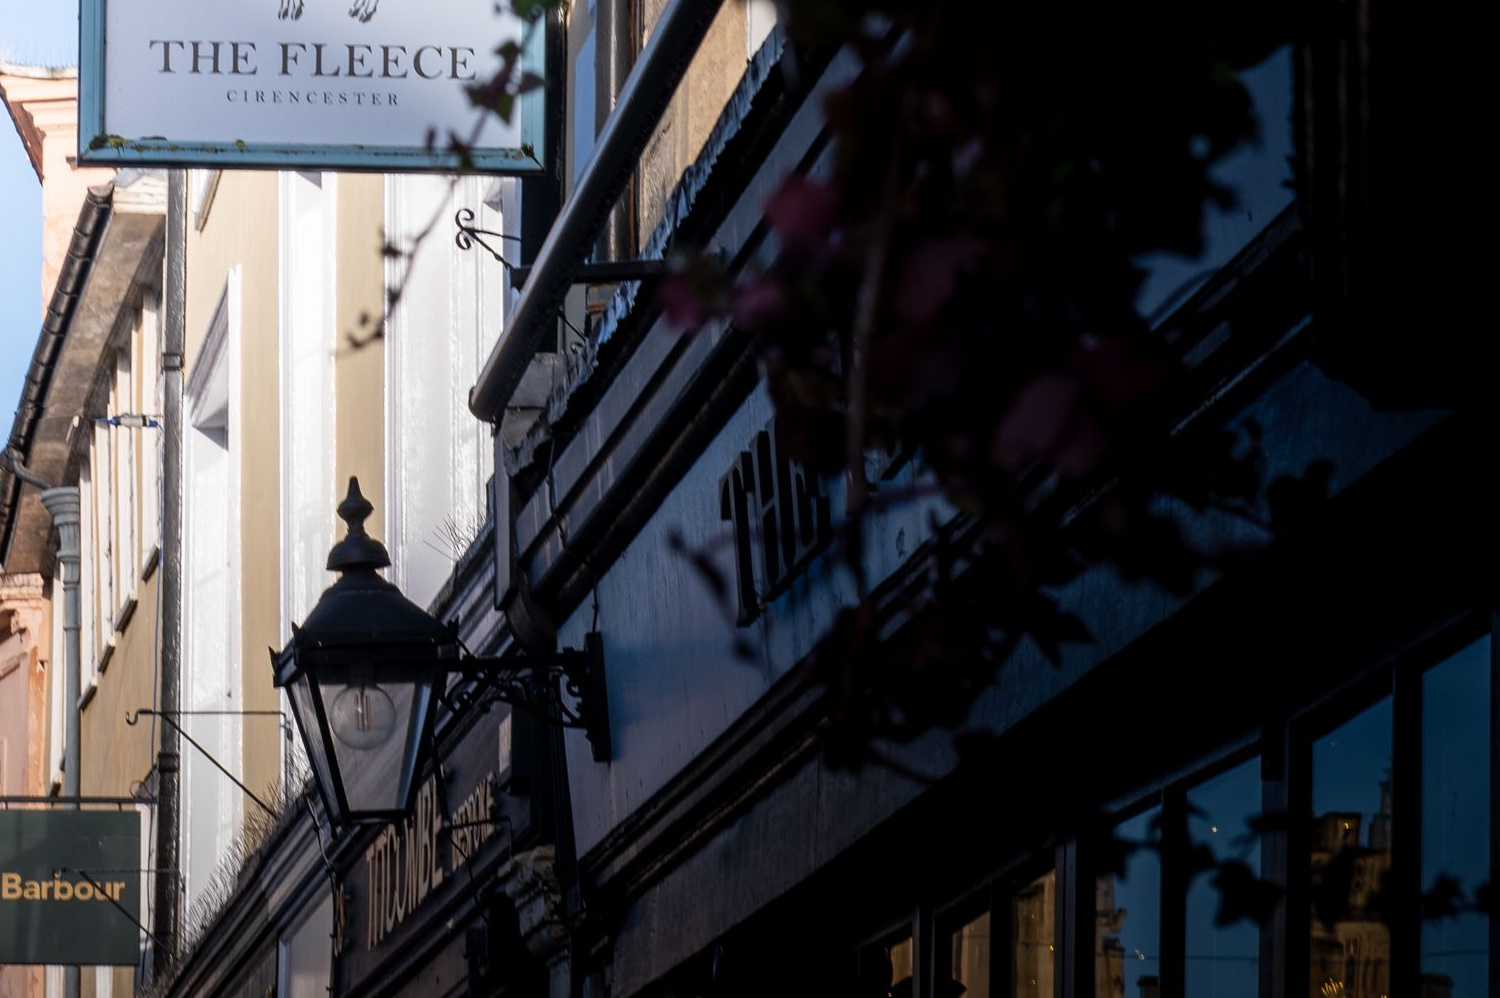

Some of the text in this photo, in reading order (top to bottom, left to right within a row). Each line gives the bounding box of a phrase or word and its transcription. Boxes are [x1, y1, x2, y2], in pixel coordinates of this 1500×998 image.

[149, 40, 477, 81] THE FLEECE
[226, 89, 400, 106] CIRENCESTER
[0, 872, 126, 902] Barbour
